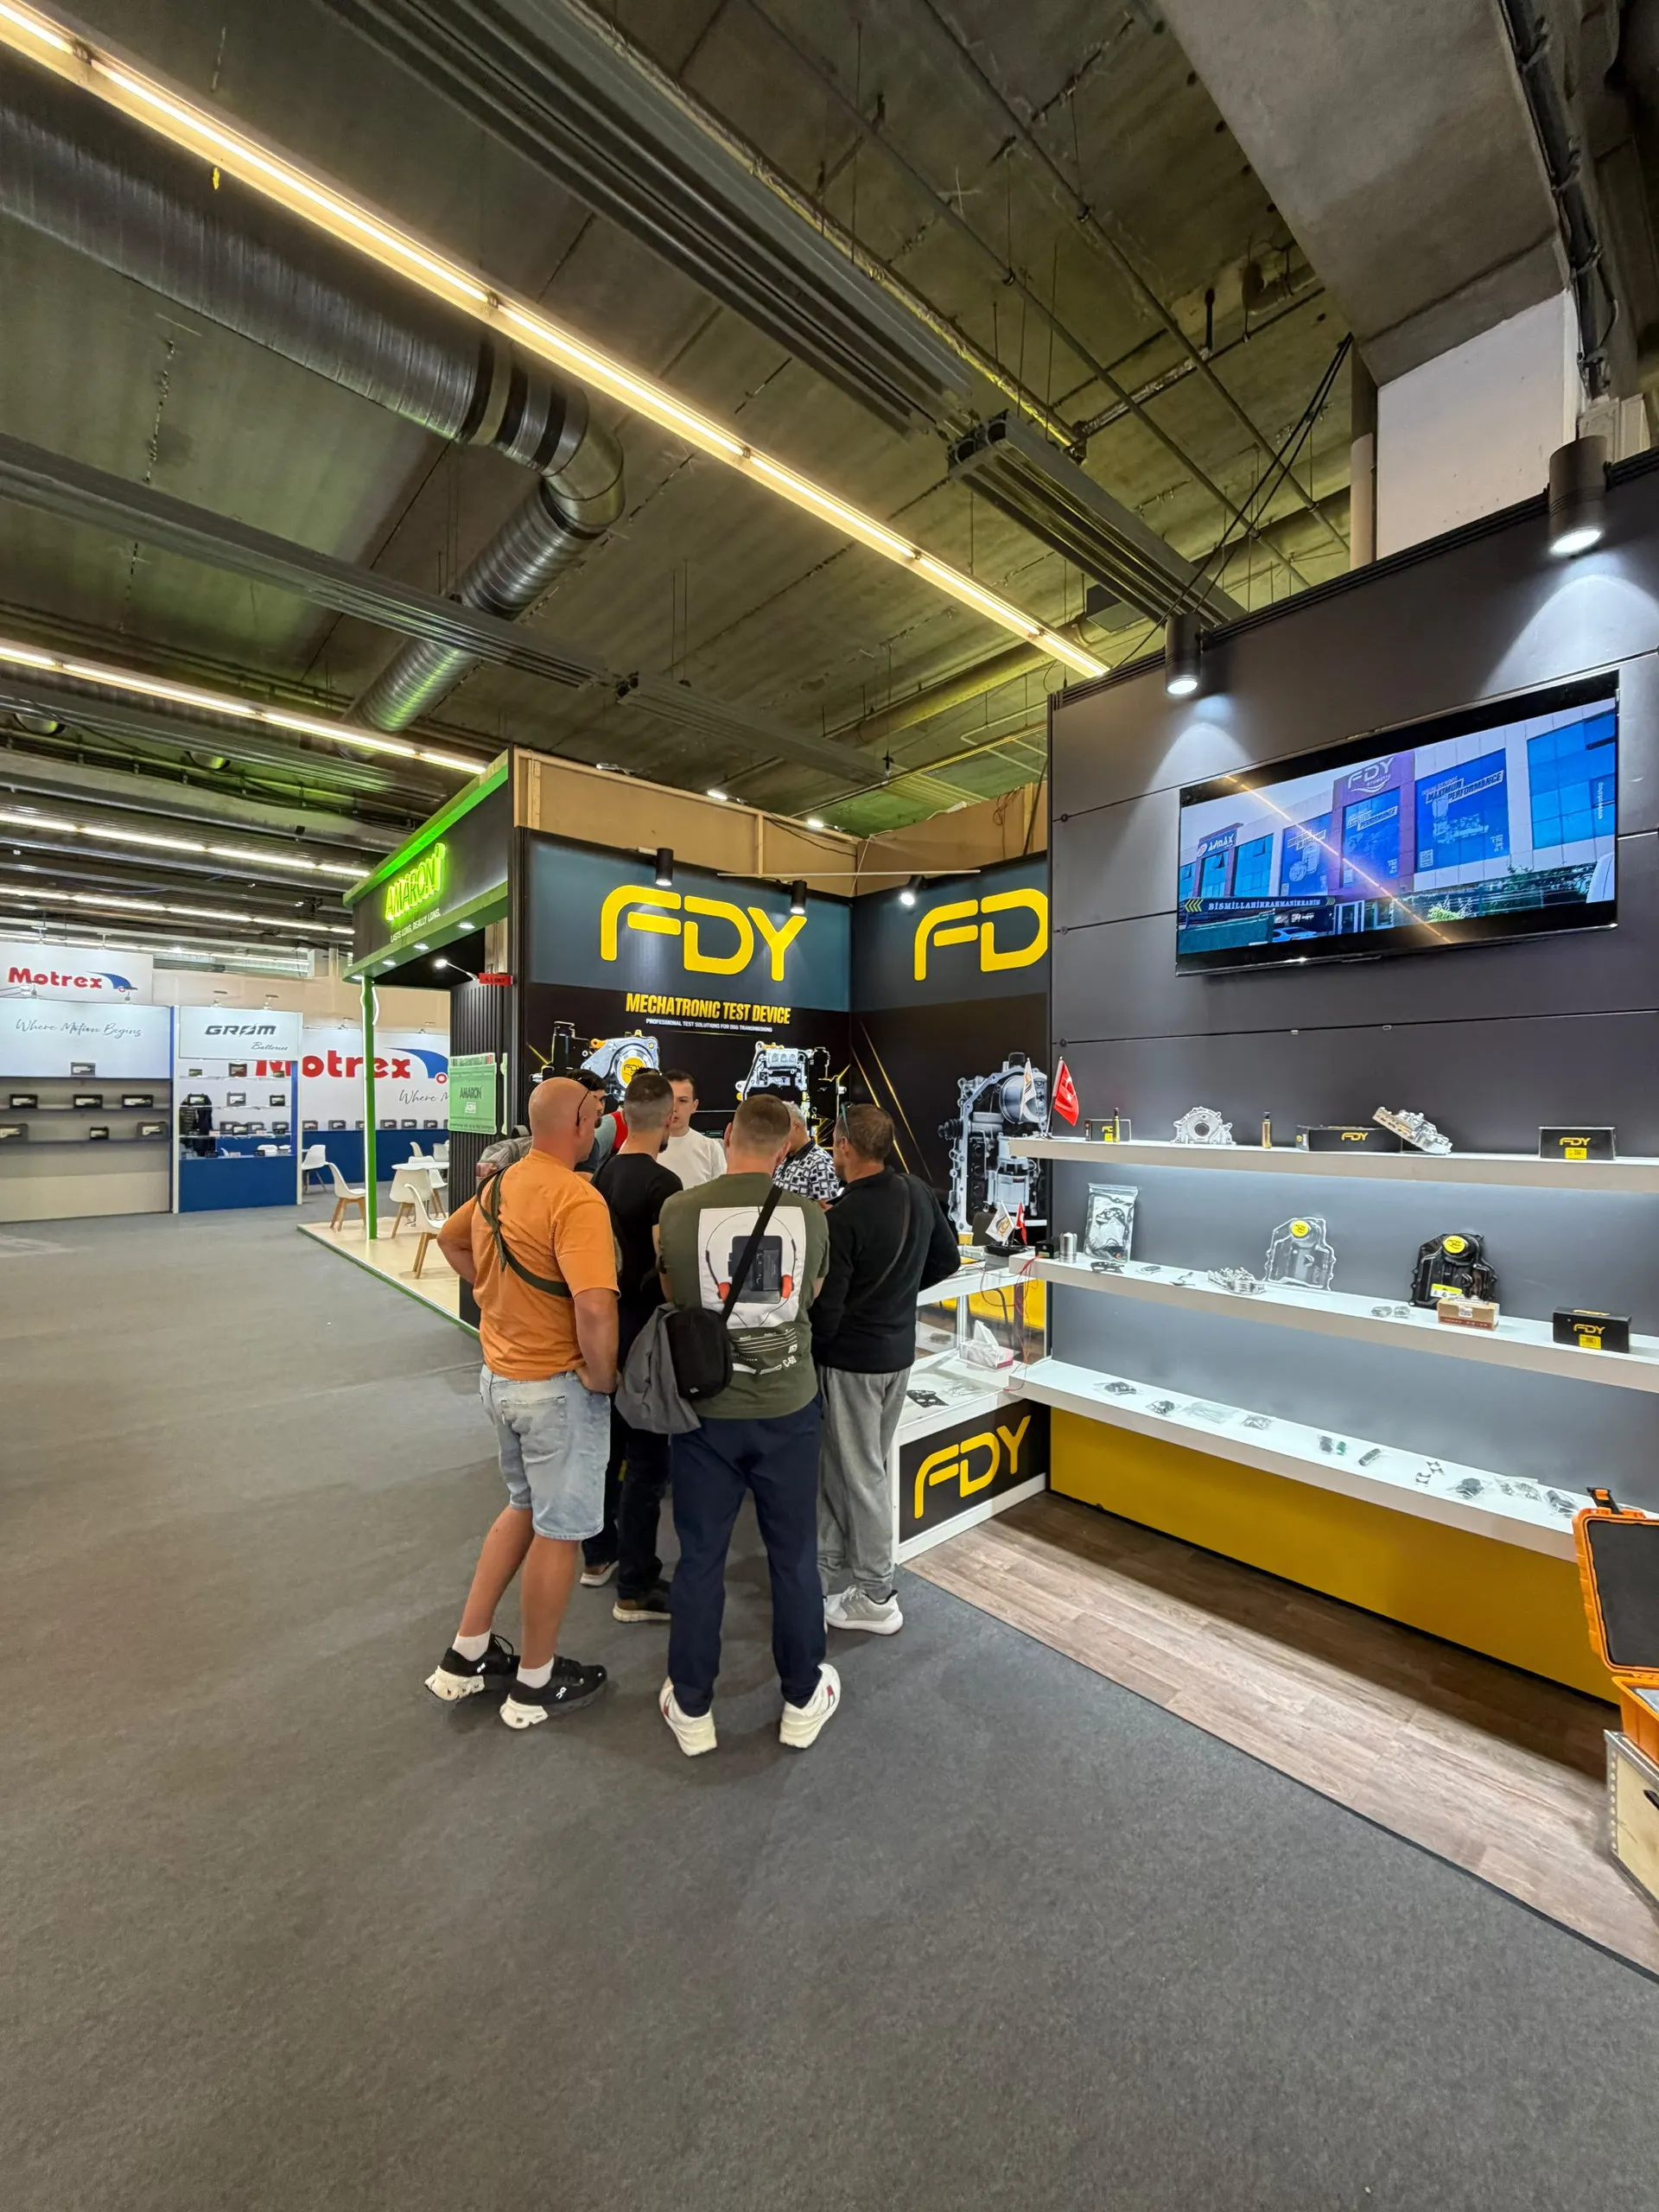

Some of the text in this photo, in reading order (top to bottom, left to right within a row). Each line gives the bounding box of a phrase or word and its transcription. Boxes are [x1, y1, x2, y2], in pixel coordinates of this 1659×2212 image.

[1348, 756, 1395, 789] FDY
[385, 849, 442, 921] AMARON
[601, 885, 807, 982] FDY
[8, 967, 103, 989] Motrex
[626, 993, 791, 1025] MECHATRONIC TEST DEVICE
[16, 1019, 143, 1039] Where Motion Begins
[645, 1018, 682, 1027] PROFESSIONAL
[251, 1041, 289, 1051] Batteries
[398, 1090, 438, 1104] Where
[1341, 1132, 1369, 1141] FDY
[1559, 1137, 1591, 1146] FDY
[1573, 1323, 1605, 1334] FDY
[914, 1414, 1032, 1519] FDY
